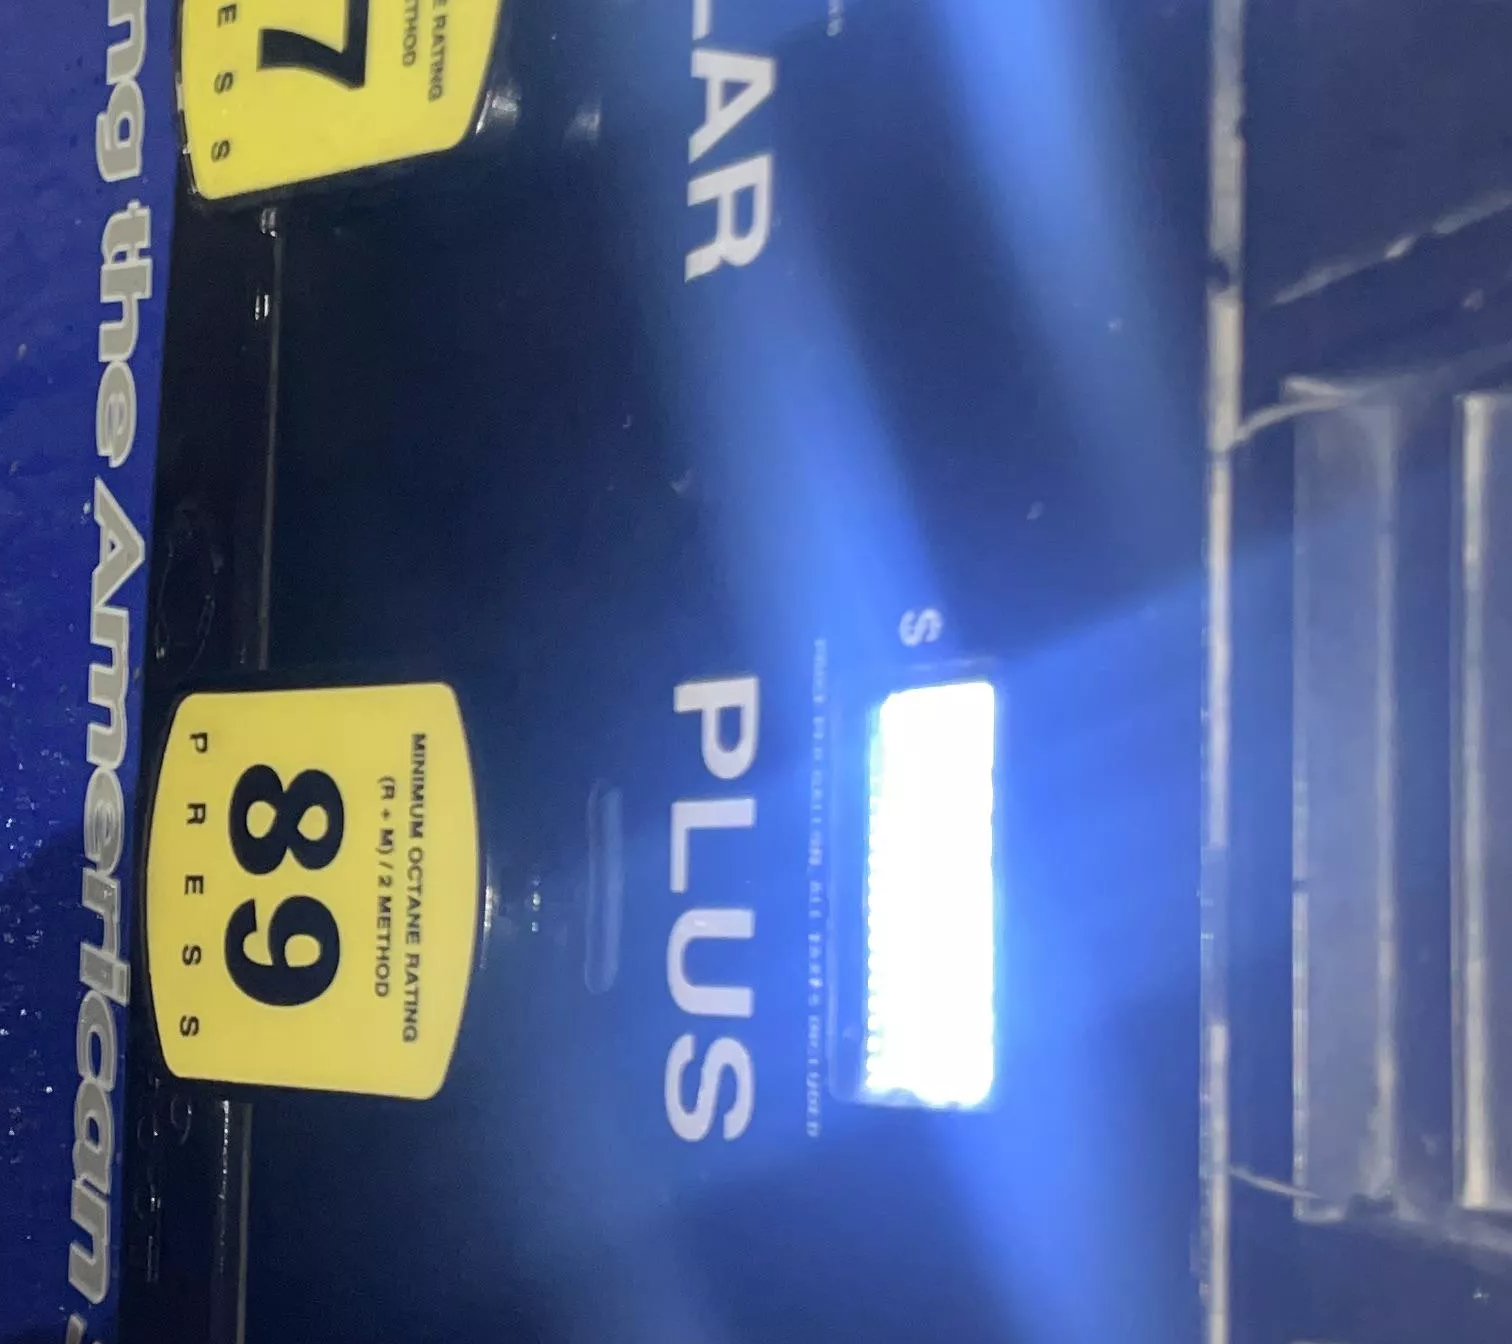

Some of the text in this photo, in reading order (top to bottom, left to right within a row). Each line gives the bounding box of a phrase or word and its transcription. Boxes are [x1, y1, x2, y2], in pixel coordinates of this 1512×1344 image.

[426, 15, 447, 102] RATING
[96, 205, 151, 469] the
[65, 473, 146, 1306] American
[177, 732, 208, 1038] PRESS
[223, 764, 344, 1007] 89
[373, 828, 395, 855] M)
[374, 776, 395, 800] (R
[376, 874, 392, 889] 2
[400, 732, 427, 1044] MINIMUM OCTANE RATING
[663, 675, 760, 1143] PLUS
[372, 895, 392, 998] METHOD
